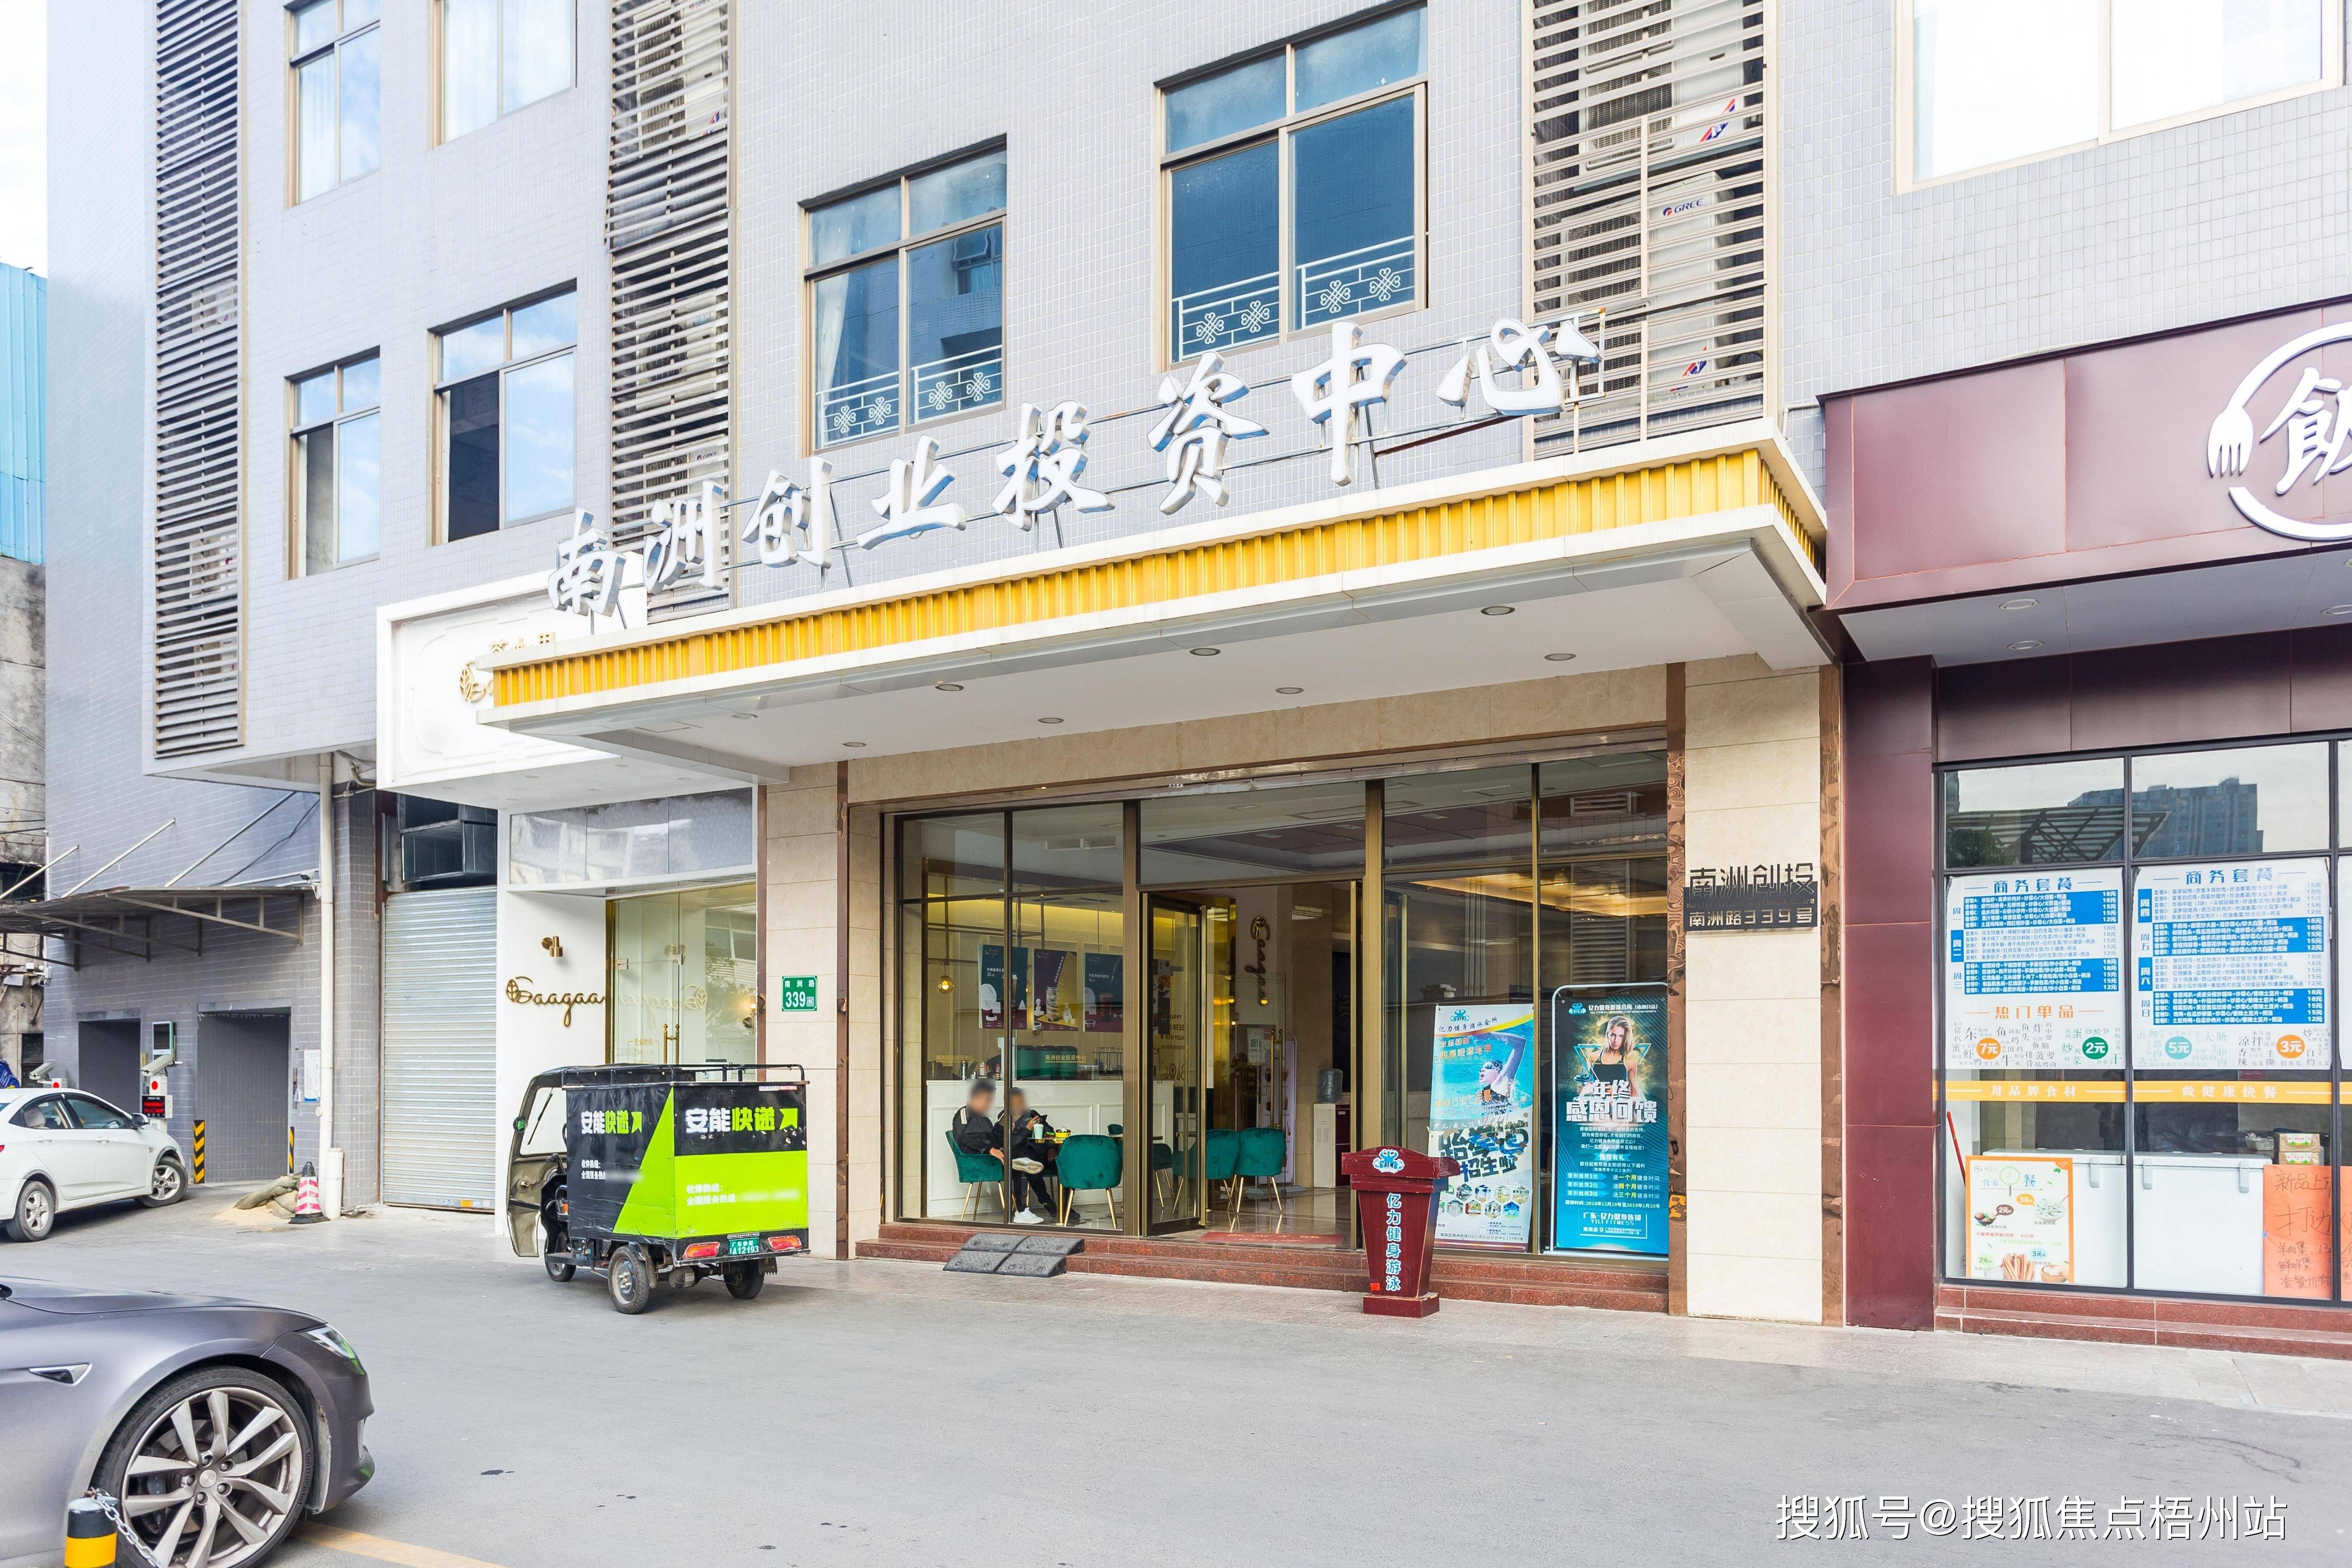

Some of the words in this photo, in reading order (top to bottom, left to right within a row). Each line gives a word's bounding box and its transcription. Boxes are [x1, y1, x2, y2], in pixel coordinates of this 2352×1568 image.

[1674, 198, 1704, 213] GREE
[548, 318, 1601, 617] 南洲创业投资中心
[2185, 867, 2273, 885] 商务套餐
[1994, 877, 2072, 893] 商务套餐
[1689, 907, 1813, 927] 南洲路339号
[785, 979, 815, 988] 南洲路
[785, 991, 806, 1008] 339
[1994, 1005, 2074, 1019] 热门单品
[1979, 1043, 1999, 1055] 7元
[2085, 1042, 2106, 1054] 2元
[2169, 1042, 2190, 1054] 5元
[2280, 1040, 2302, 1053] 3元
[1593, 1080, 1631, 1099] 年终
[1990, 1085, 2077, 1098] 用品牌食材
[2182, 1085, 2278, 1098] 做健康快餐
[1565, 1099, 1658, 1123] 感恩回馈
[581, 1110, 629, 1134] 安能快递
[685, 1106, 775, 1133] 安能快递
[1433, 1118, 1486, 1130] 少儿/成人跆拳
[1386, 1193, 1402, 1291] 亿力健身游泳
